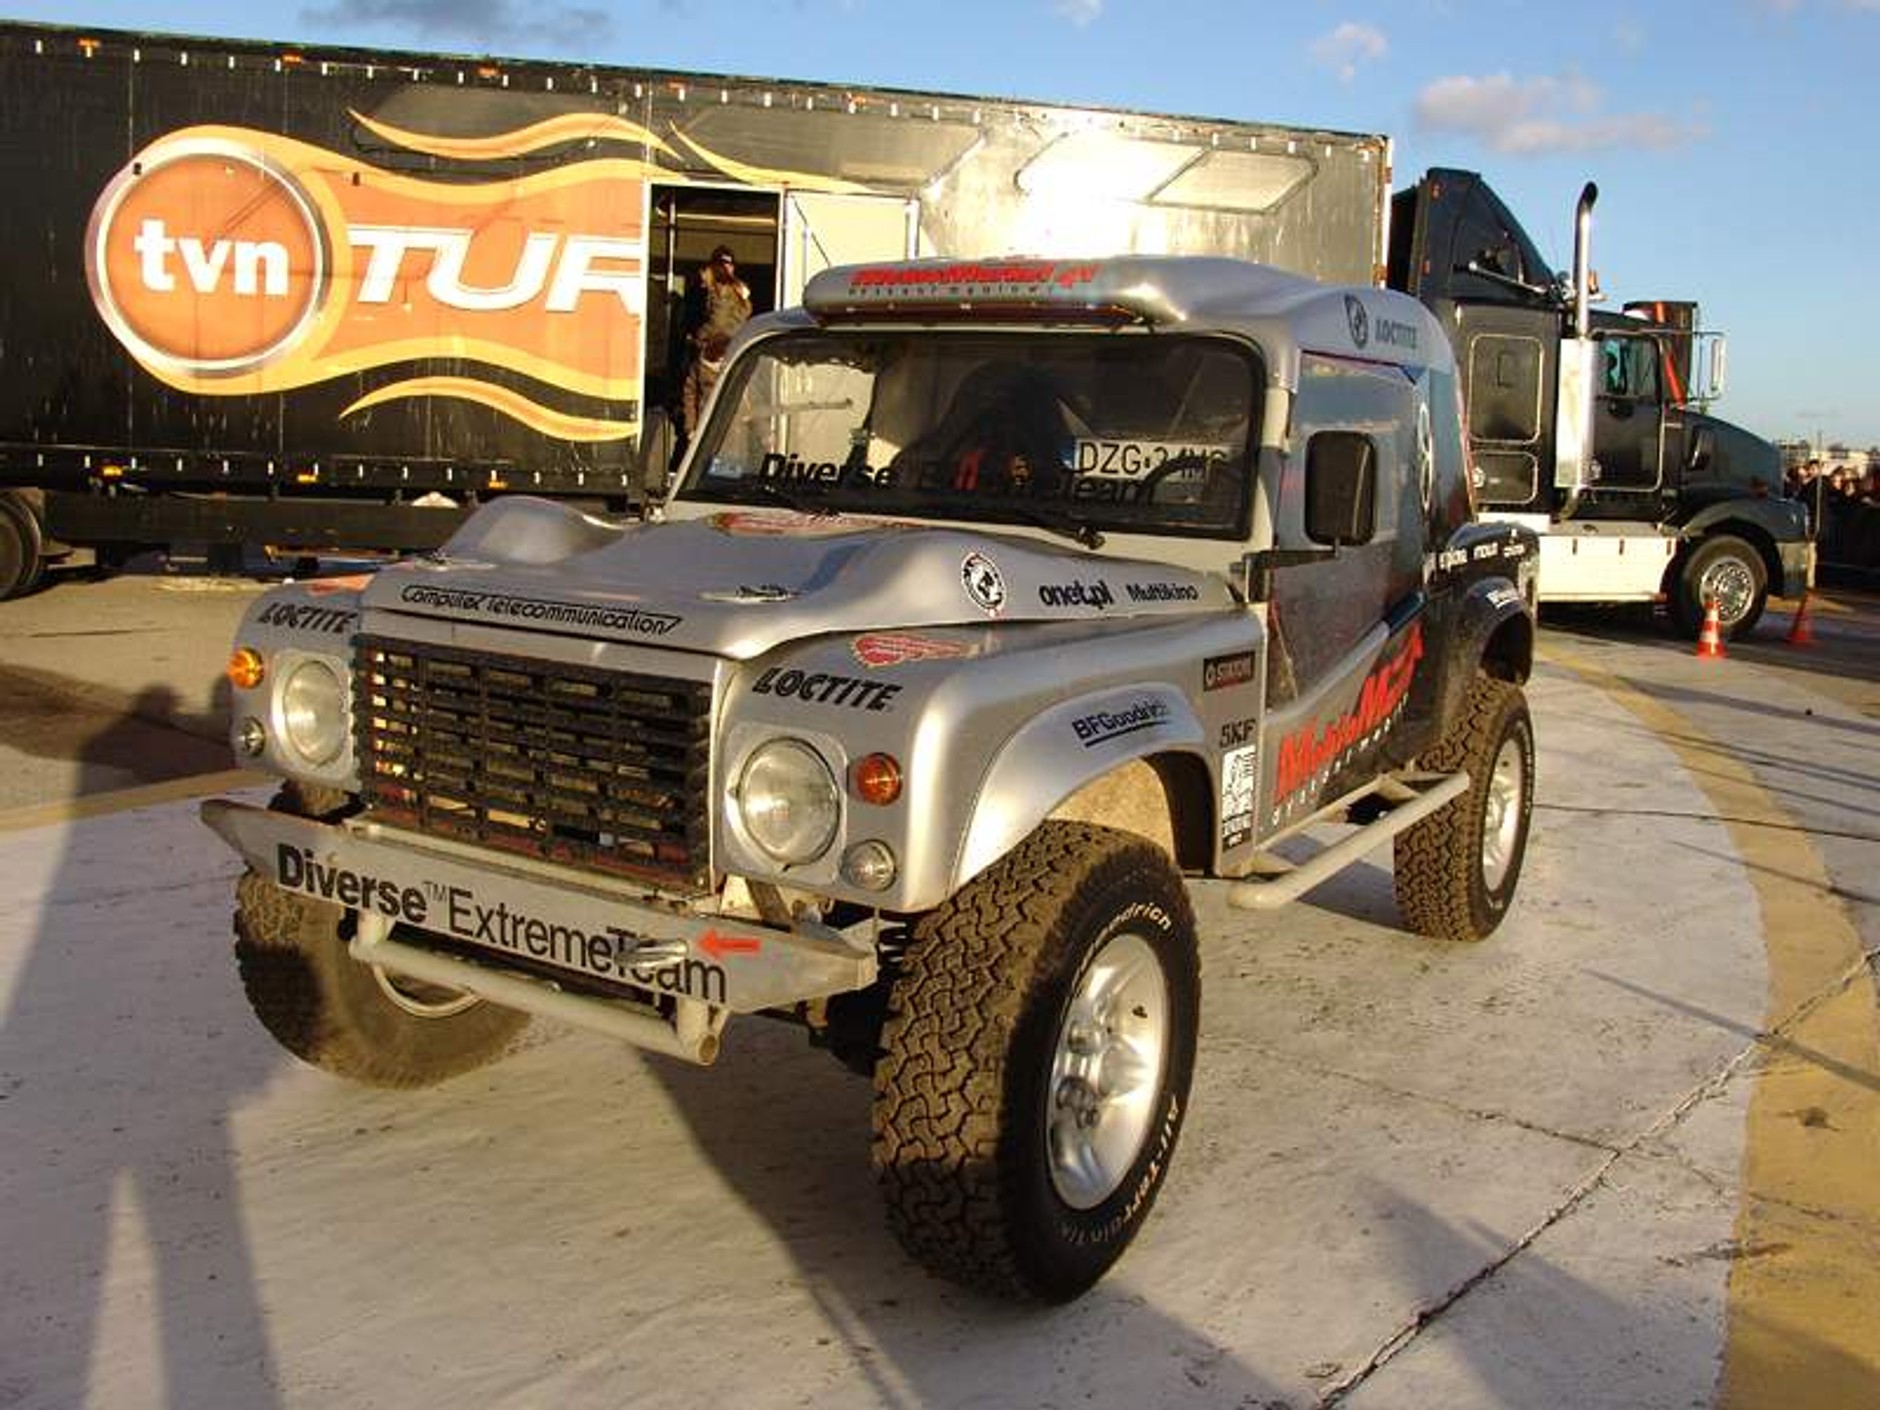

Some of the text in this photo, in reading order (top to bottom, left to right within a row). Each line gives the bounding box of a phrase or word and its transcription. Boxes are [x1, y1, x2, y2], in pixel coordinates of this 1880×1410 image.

[134, 219, 288, 296] tvn
[1079, 442, 1142, 475] DZG
[1038, 580, 1114, 609] onet.pl
[1126, 583, 1199, 602] Multikino
[258, 602, 358, 633] LOCTITE
[752, 667, 903, 712] LOCTITE
[276, 842, 427, 923] Diverse
